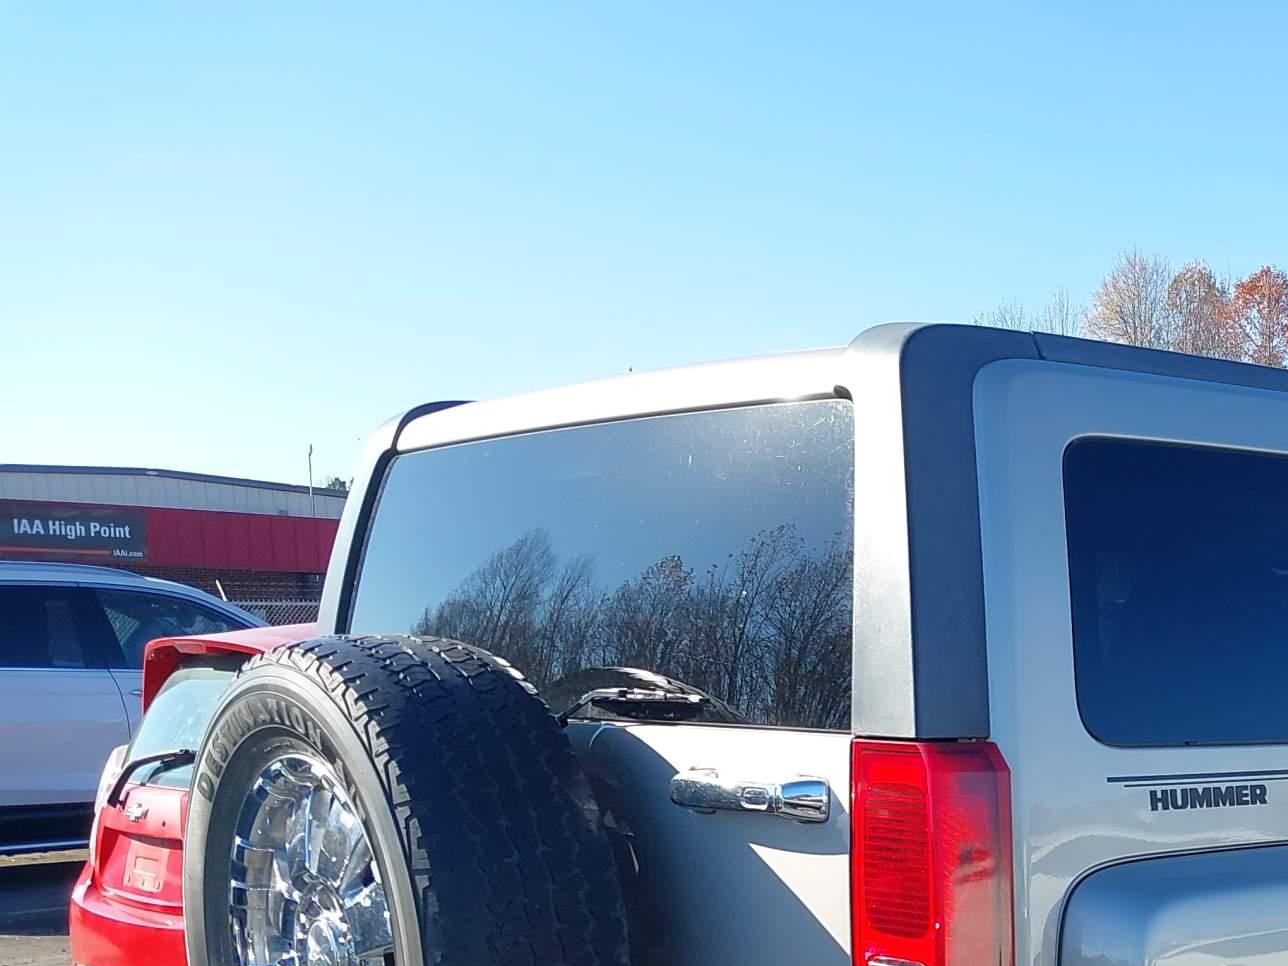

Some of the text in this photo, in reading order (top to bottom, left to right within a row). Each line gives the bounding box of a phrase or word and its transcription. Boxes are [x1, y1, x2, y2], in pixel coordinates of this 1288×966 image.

[13, 518, 131, 539] IAA High Point
[1149, 783, 1268, 812] HUMMER
